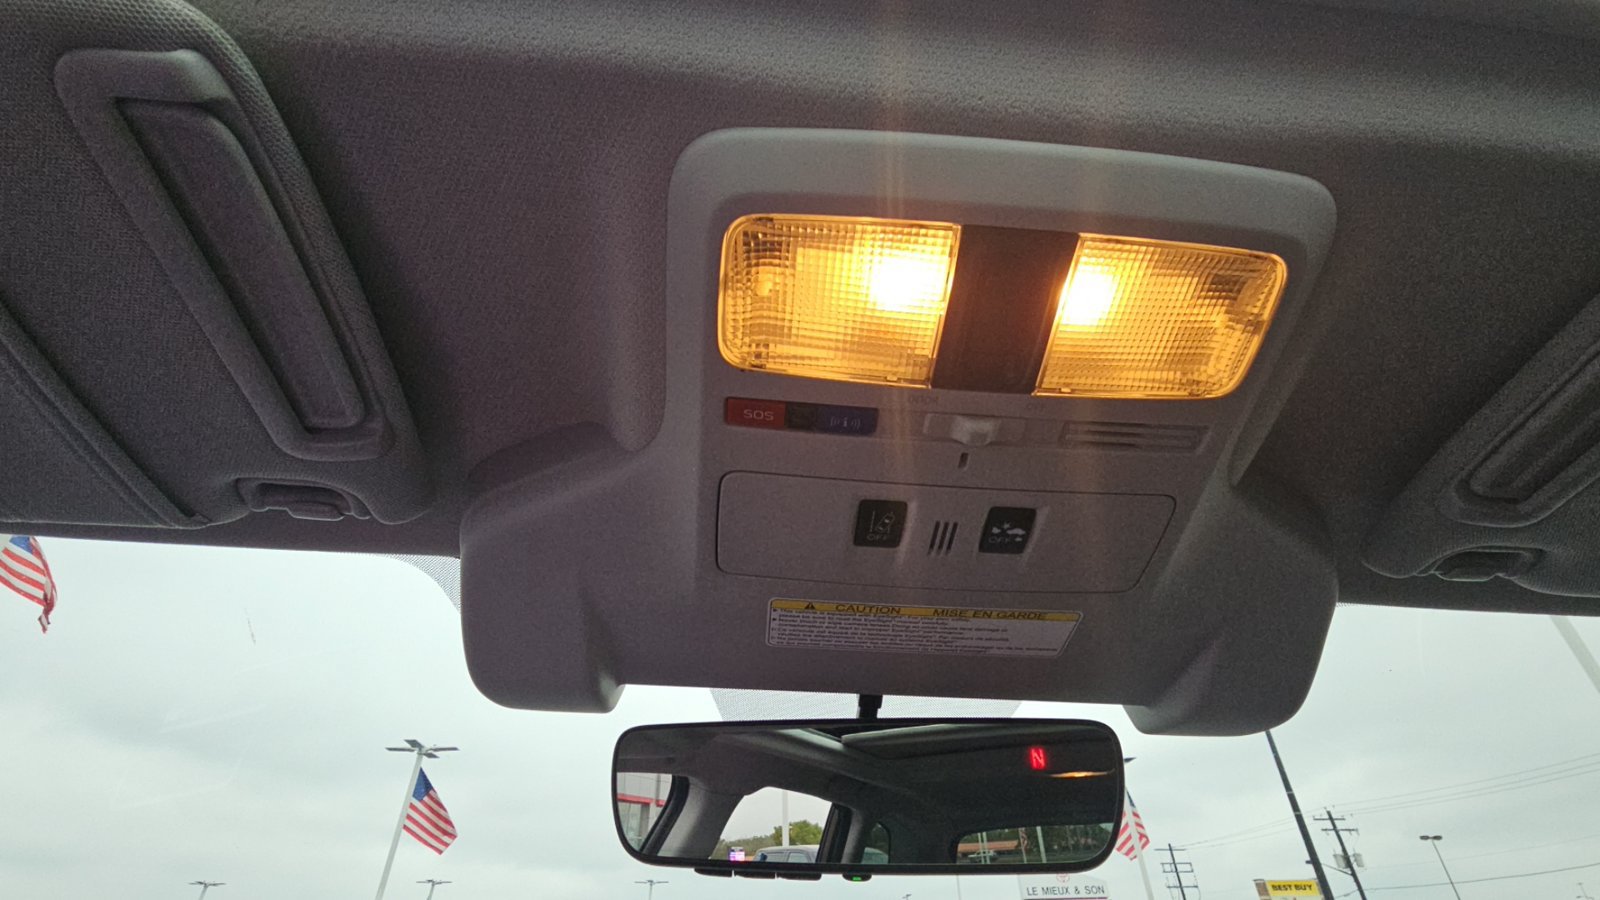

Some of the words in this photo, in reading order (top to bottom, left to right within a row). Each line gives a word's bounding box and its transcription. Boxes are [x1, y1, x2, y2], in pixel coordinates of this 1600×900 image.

[743, 408, 775, 421] SOS
[866, 533, 888, 541] OFF
[835, 603, 901, 615] CAUTION
[932, 608, 969, 618] MISE
[972, 610, 993, 619] EN
[996, 611, 1047, 621] GARDE
[1030, 747, 1046, 769] N
[1026, 886, 1038, 896] LE
[1041, 886, 1071, 896] MIEUX
[1074, 885, 1080, 895] &
[1084, 885, 1105, 895] SON
